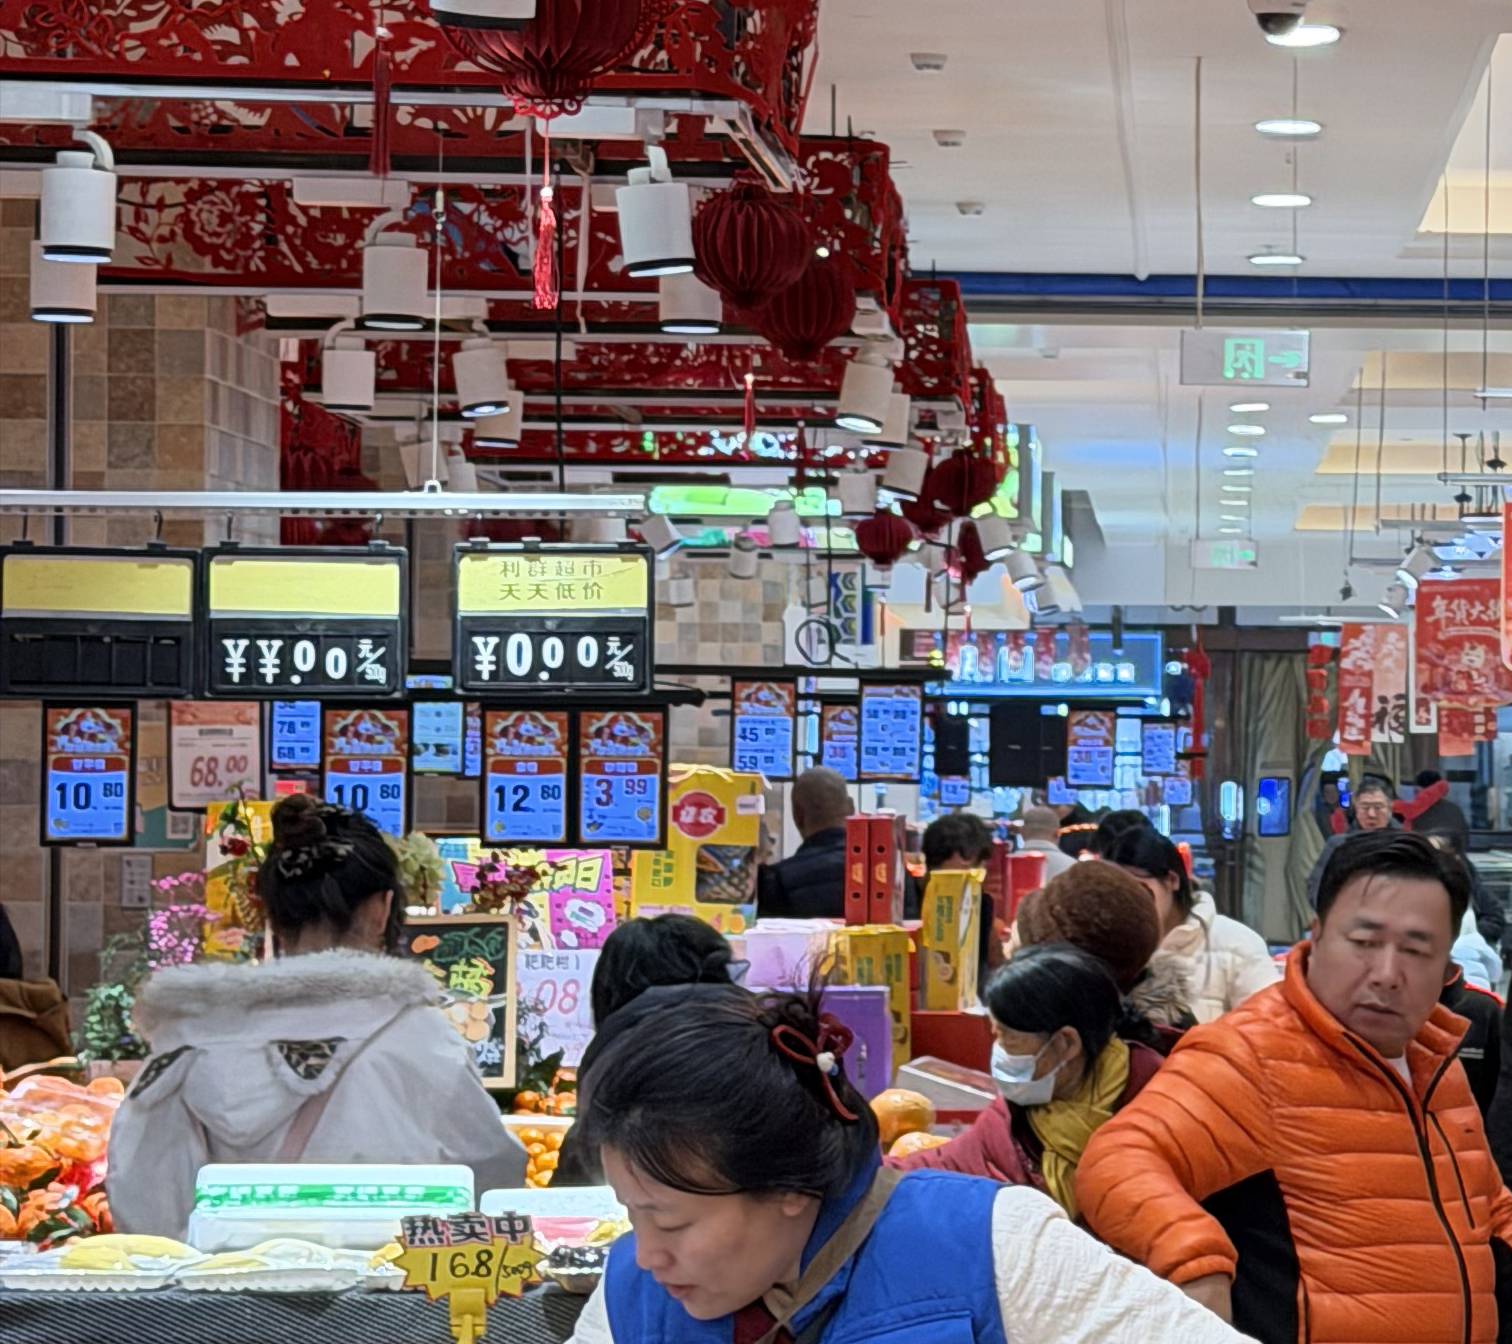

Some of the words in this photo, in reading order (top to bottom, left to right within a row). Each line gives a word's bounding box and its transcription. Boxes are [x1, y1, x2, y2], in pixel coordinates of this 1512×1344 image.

[499, 581, 604, 602] 天天低价
[55, 782, 92, 811] 10
[404, 1211, 532, 1248] 热卖中
